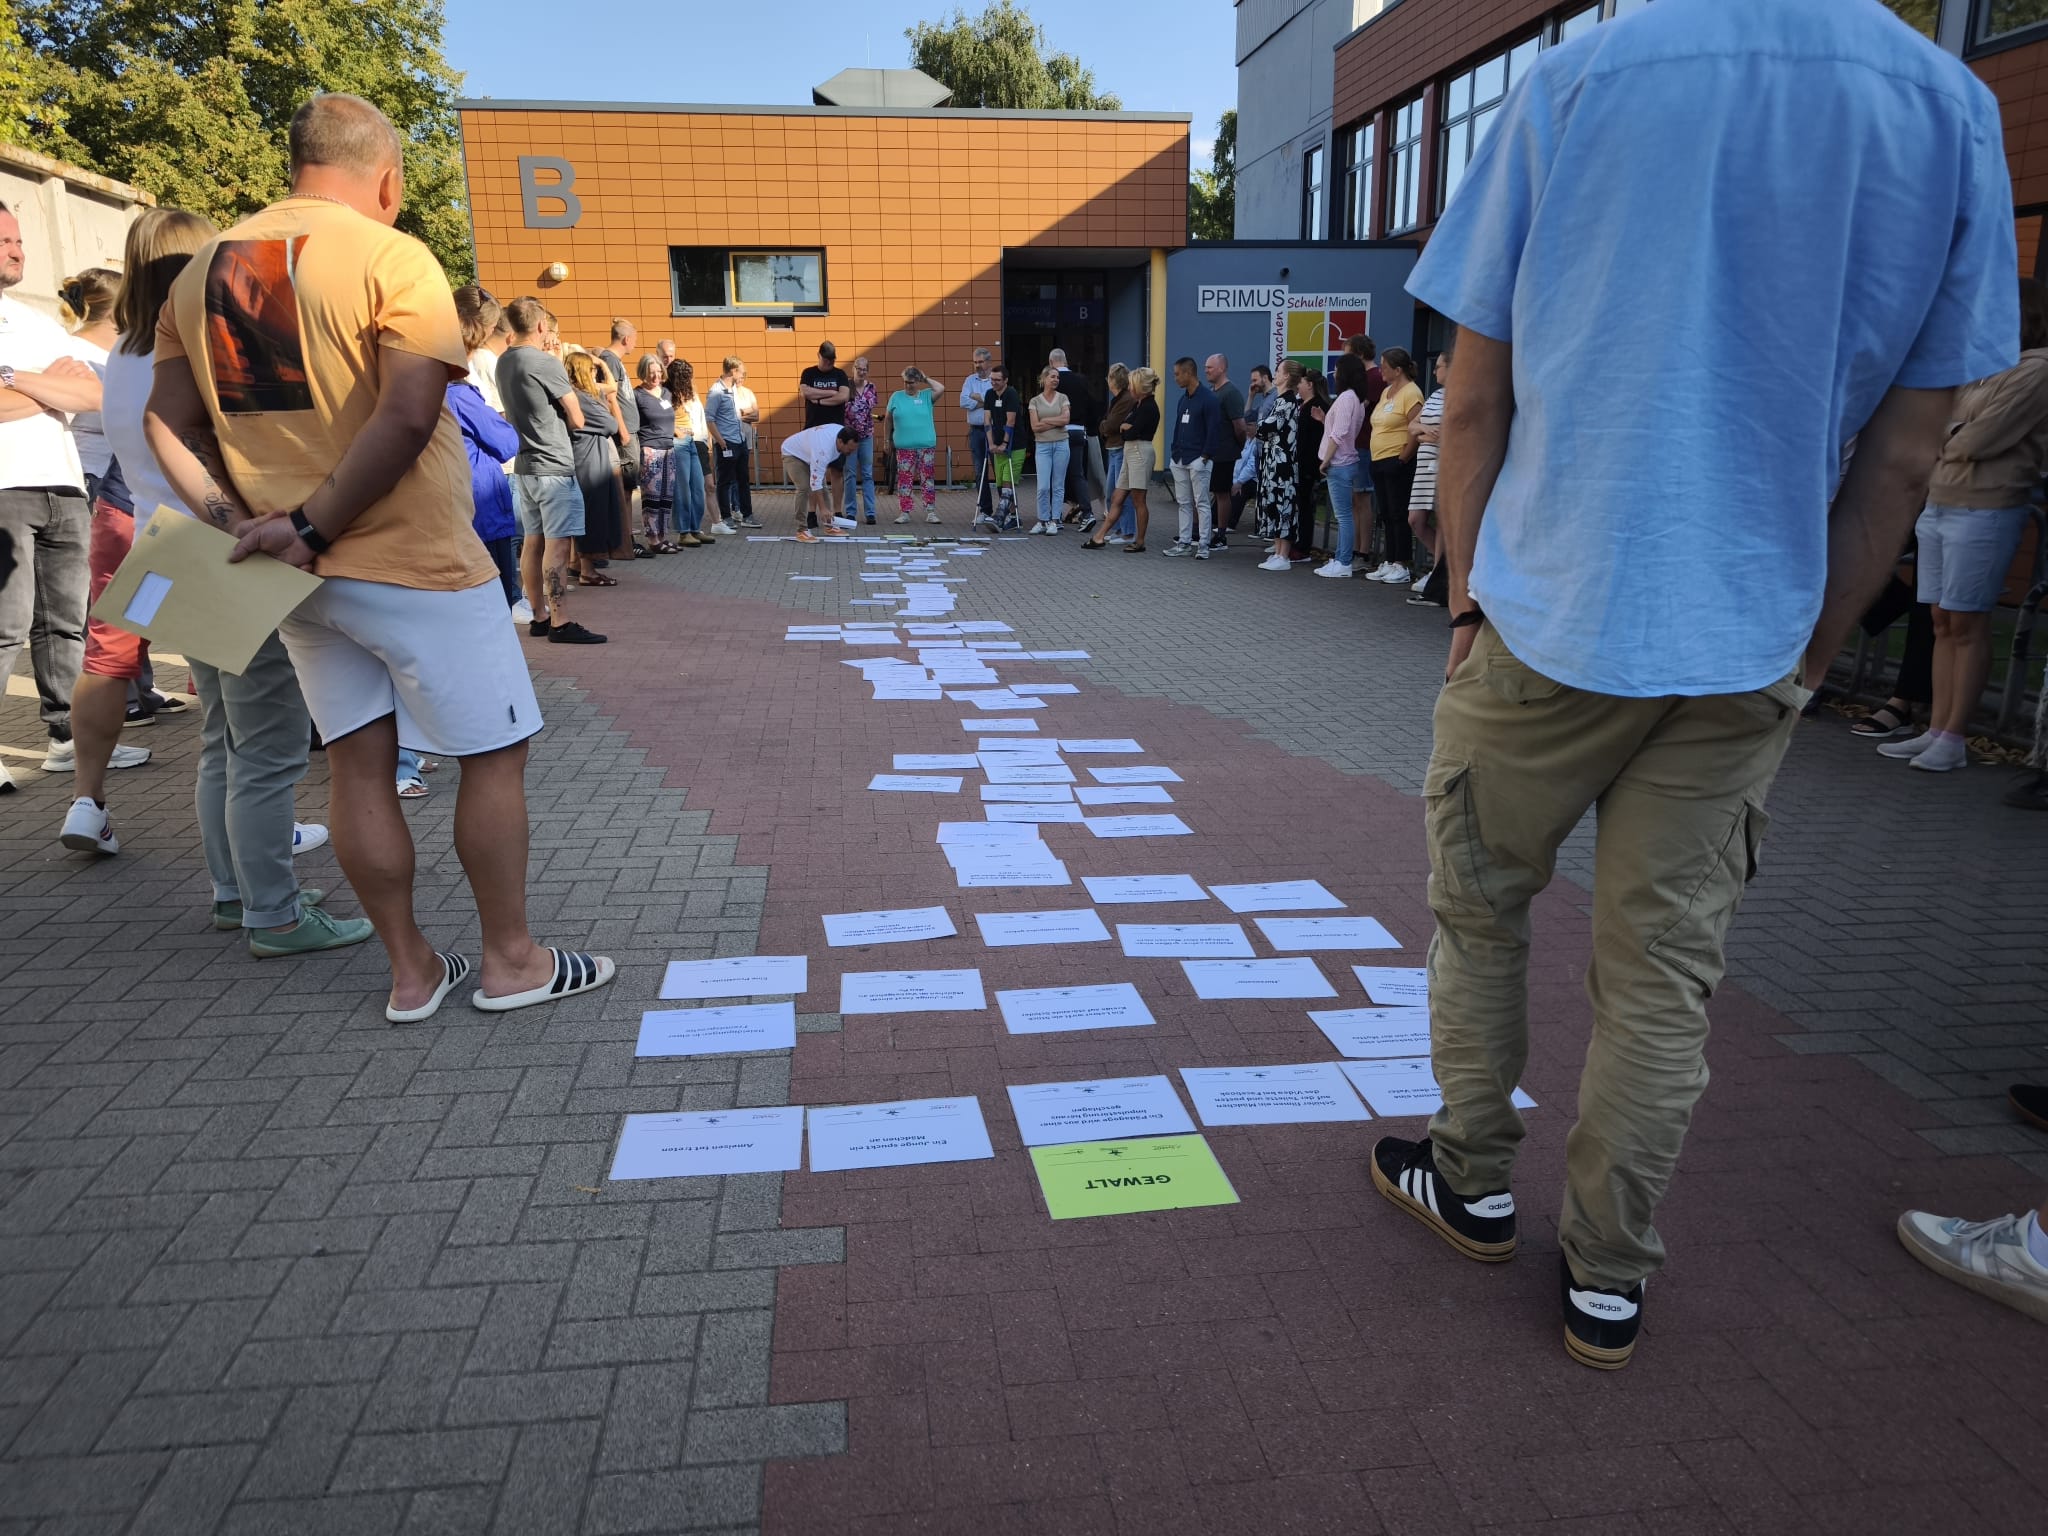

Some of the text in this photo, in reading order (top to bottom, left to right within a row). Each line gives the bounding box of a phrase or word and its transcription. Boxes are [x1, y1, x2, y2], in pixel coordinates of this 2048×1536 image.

[518, 156, 581, 228] B
[1202, 289, 1284, 308] PRIMUS
[1288, 296, 1367, 308] Schule! Minden
[1080, 307, 1088, 319] B
[1273, 312, 1284, 364] machen
[1083, 1109, 1147, 1117] Impulsstörung
[1085, 1175, 1171, 1190] GEWALT
[1588, 1302, 1622, 1312] adidas
